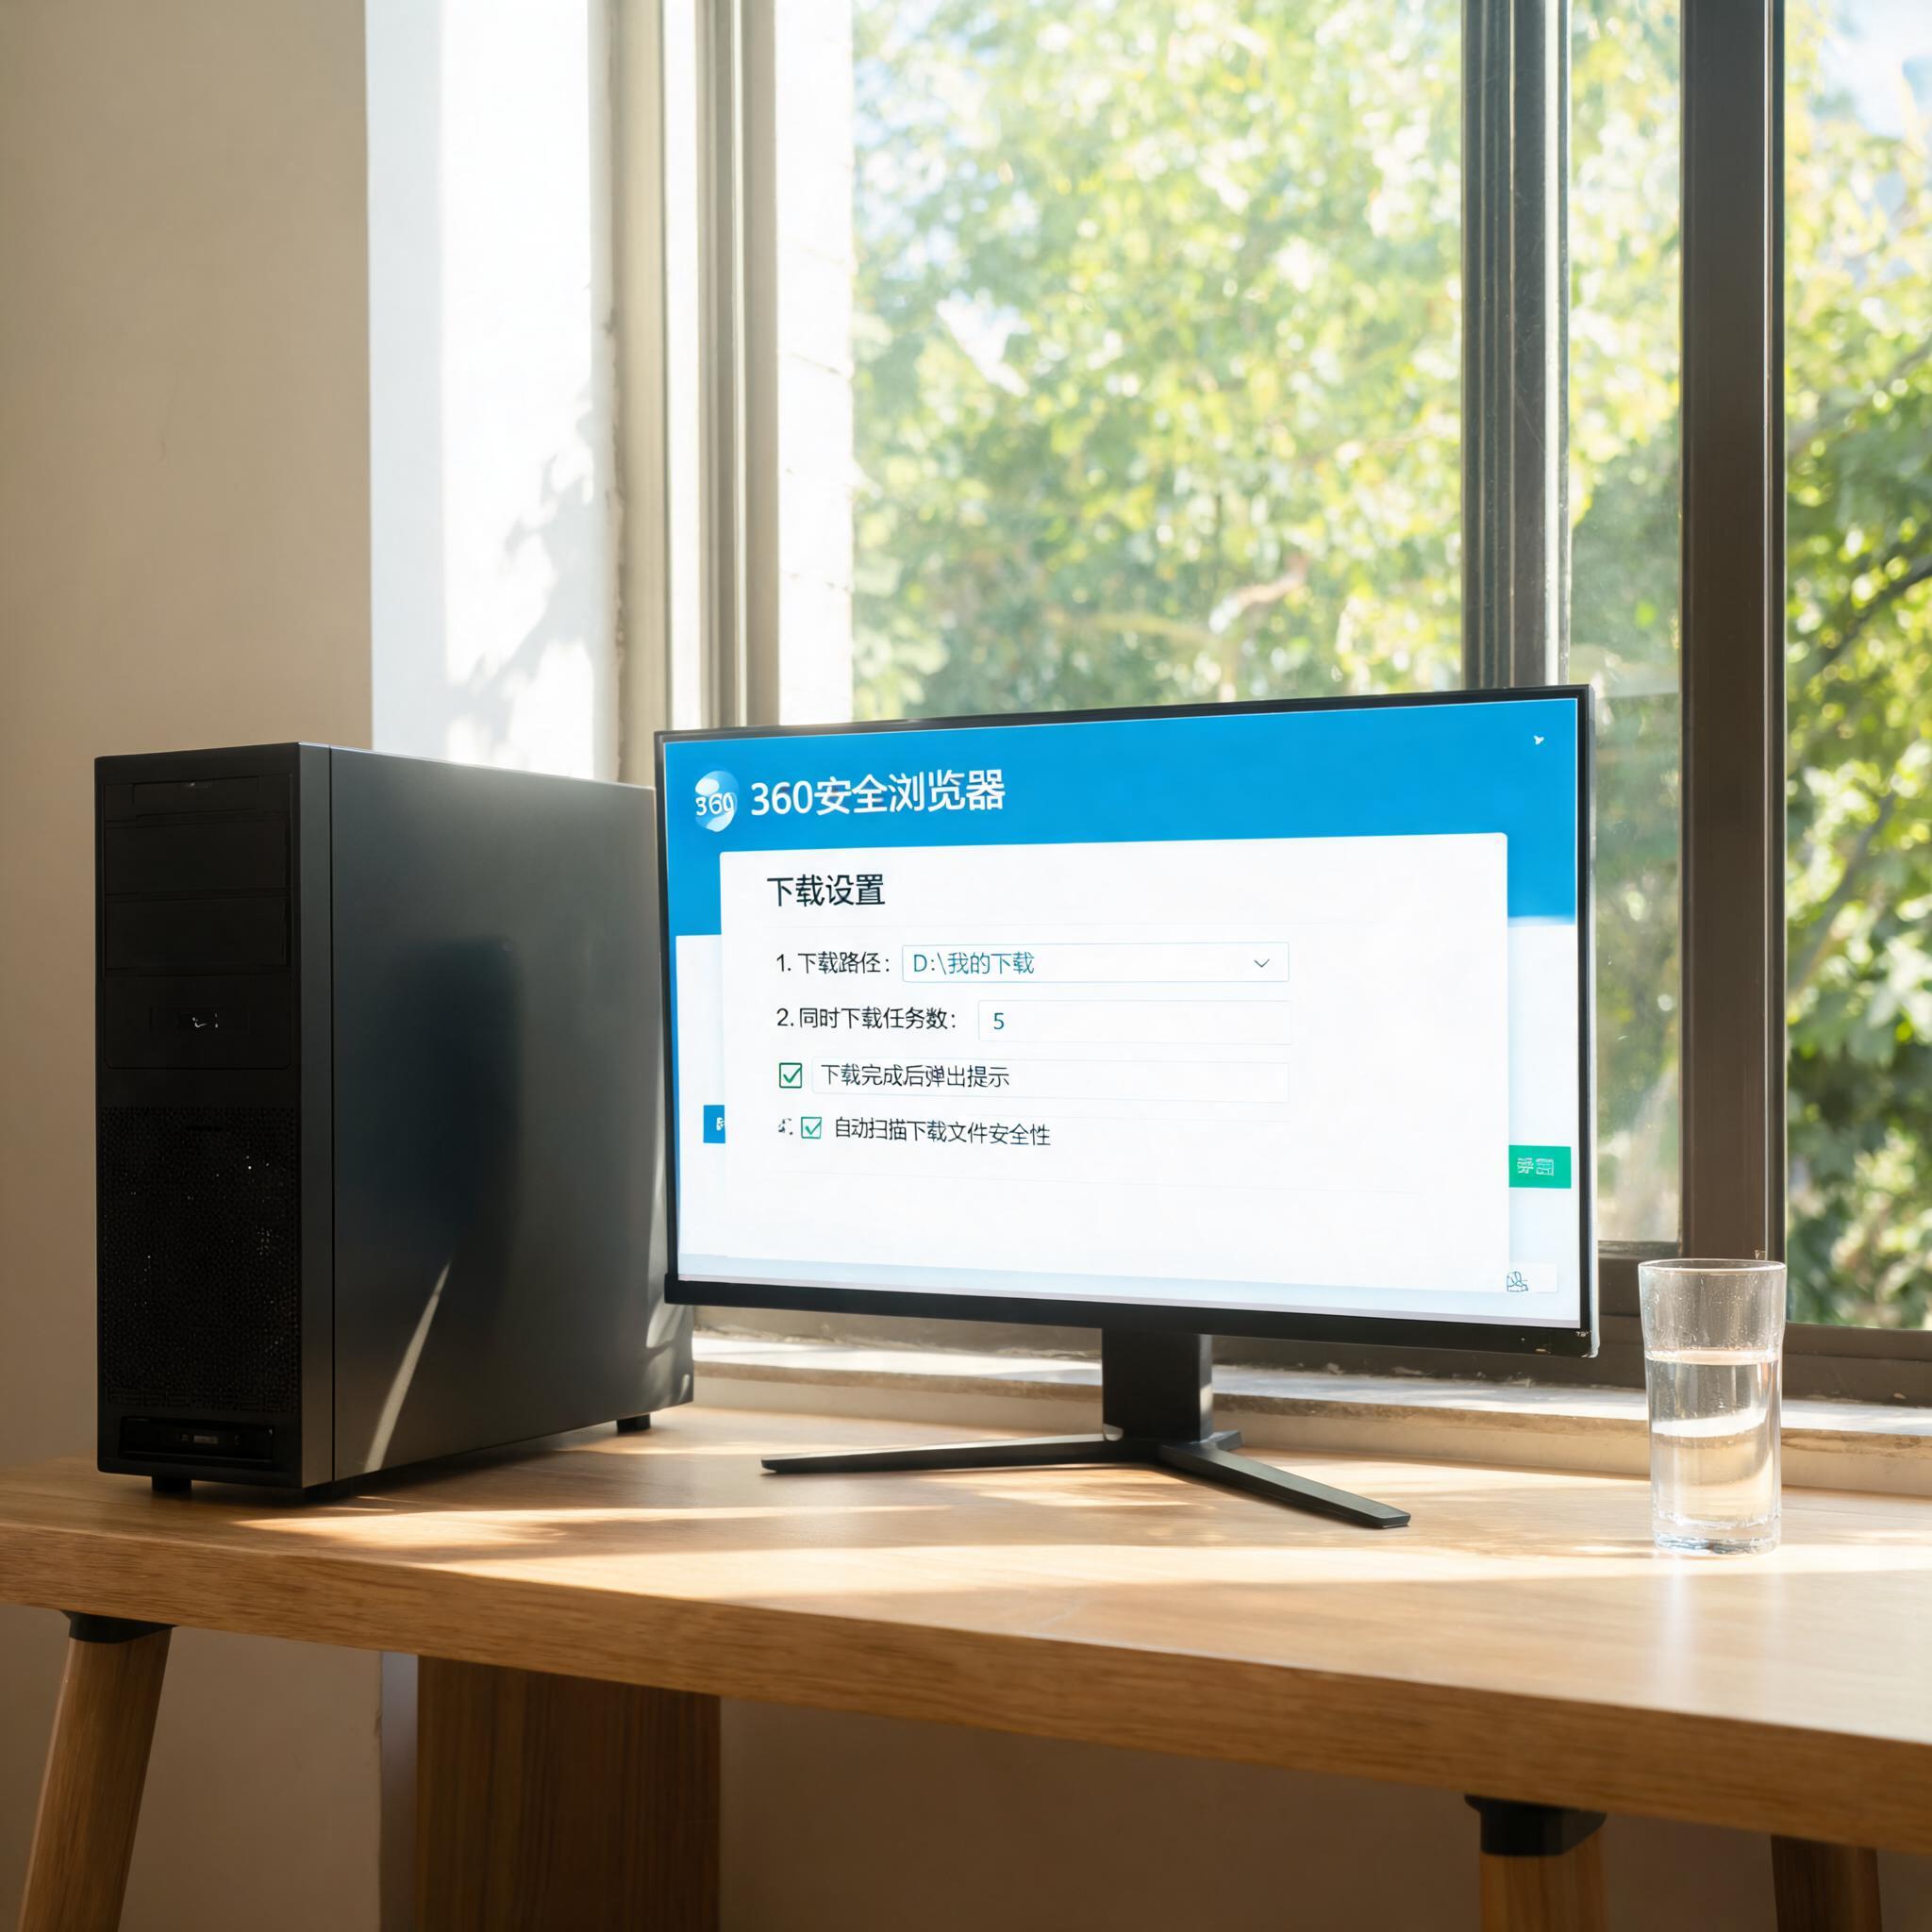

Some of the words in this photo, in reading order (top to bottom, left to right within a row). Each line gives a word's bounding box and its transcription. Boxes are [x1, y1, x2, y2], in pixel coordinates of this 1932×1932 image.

[695, 791, 735, 816] 360
[751, 769, 1006, 816] 360安全浏览器
[766, 874, 886, 908] 下载设置
[913, 951, 1035, 975] D:\我的下载
[993, 1012, 1006, 1030] 5
[821, 1063, 1009, 1088] 下载完成后弹出提示
[835, 1116, 1051, 1146] 自动扫描下载文件安全性
